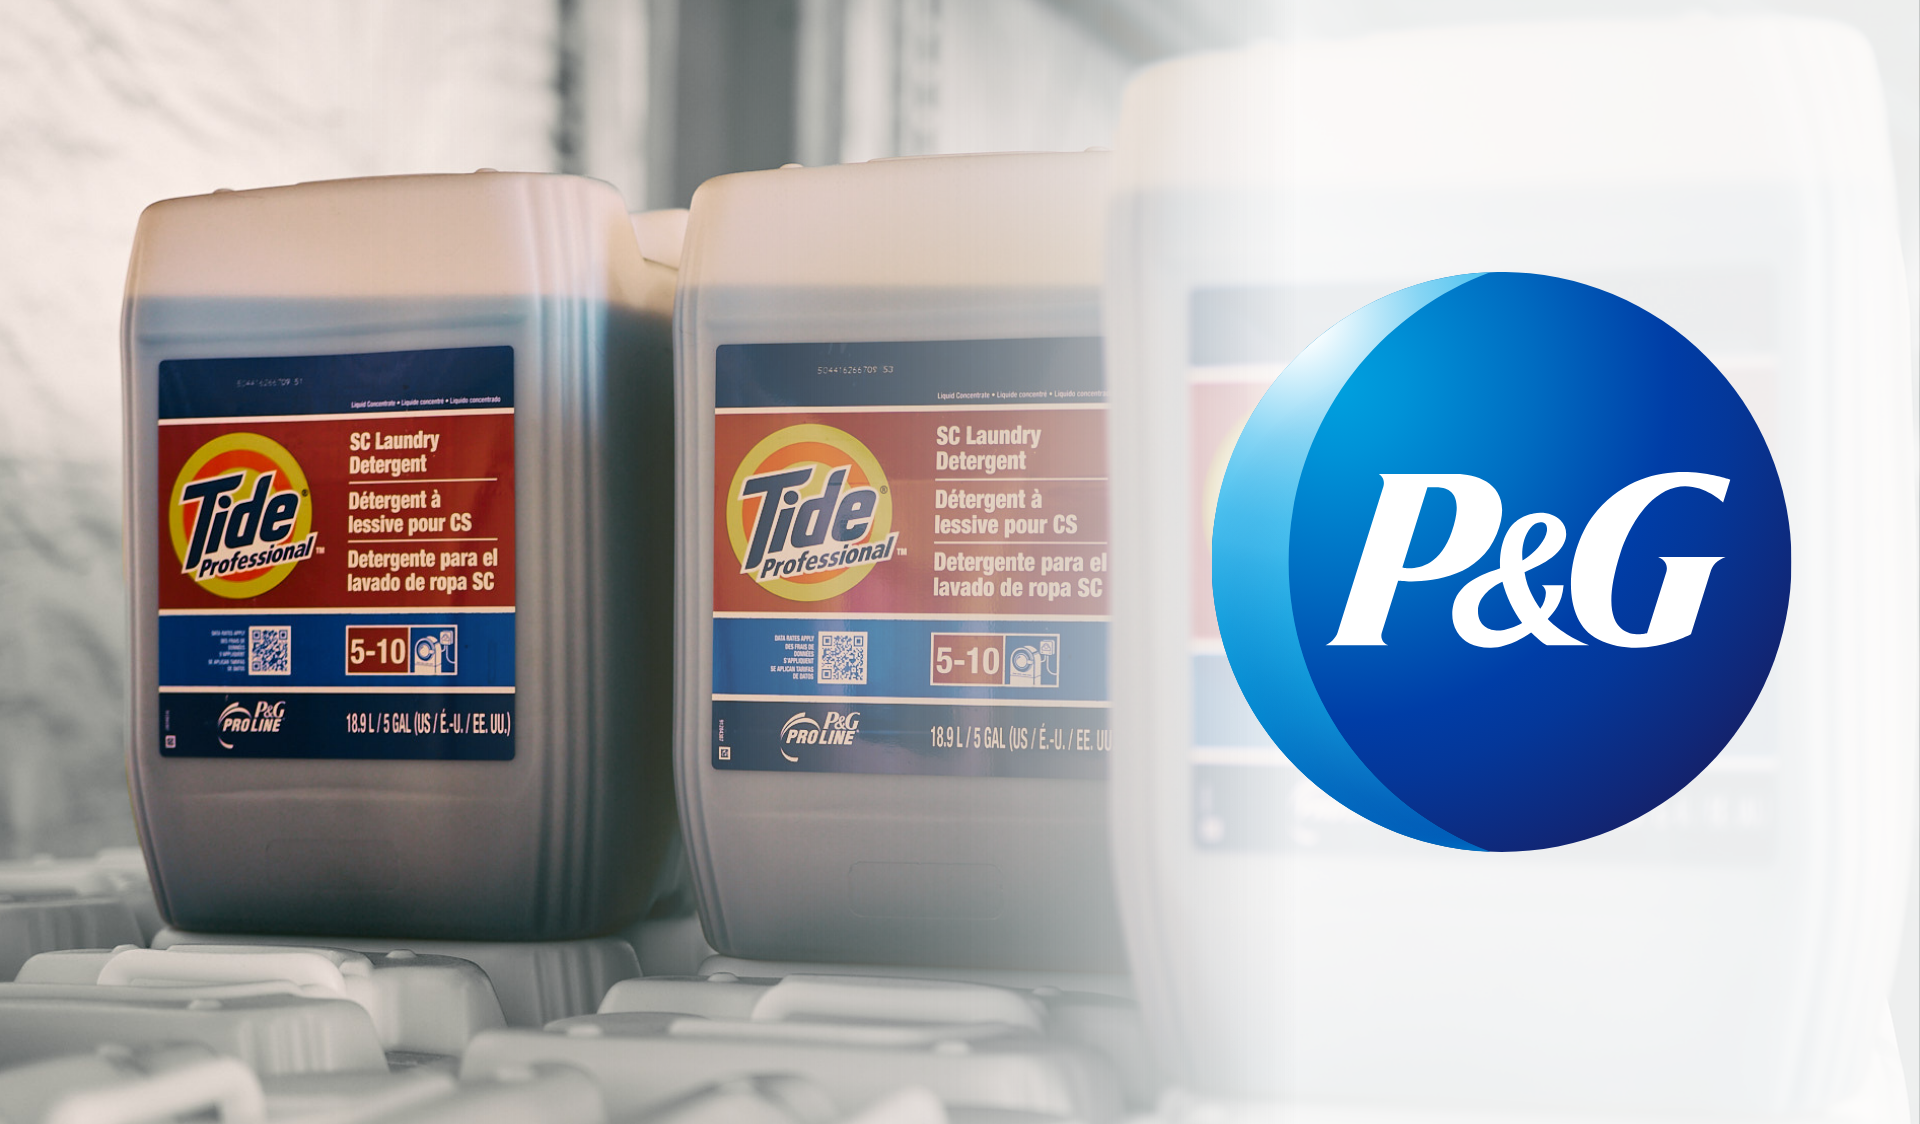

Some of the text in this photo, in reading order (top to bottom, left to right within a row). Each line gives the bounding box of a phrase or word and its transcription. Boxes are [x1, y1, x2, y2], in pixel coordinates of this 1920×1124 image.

[351, 401, 366, 409] Liquid
[367, 400, 396, 408] Concentrate
[937, 391, 955, 400] Liquid
[956, 391, 990, 399] Concentrate
[996, 391, 1018, 399] Liquide
[1019, 390, 1047, 398] concentré
[1077, 390, 1109, 398] concentra
[350, 430, 440, 452] SC Laundry
[936, 425, 1042, 449] SC Laundry
[349, 454, 427, 477] Detergent
[936, 450, 1027, 475] Detergent
[348, 488, 441, 513] Détergent à
[935, 488, 1042, 513] Détergent à
[178, 470, 302, 574] Tide
[348, 512, 472, 536] lessive pour CS
[738, 464, 879, 574] Tide
[934, 514, 1078, 538] lessive pour CS
[197, 534, 316, 579] Professional
[347, 547, 498, 572] Detergente para el
[759, 534, 896, 580] Professional
[934, 551, 1107, 576] Detergente para el
[347, 571, 495, 595] lavado de ropa SC
[933, 577, 1103, 601] lavado de ropa SC
[350, 638, 406, 664] 5-10
[936, 647, 1000, 675] 5-10
[254, 700, 286, 718] P&G
[822, 711, 861, 731] P&G
[346, 712, 367, 733] 18.9
[368, 712, 375, 733] L
[383, 713, 390, 733] 5
[392, 712, 411, 734] GAL
[414, 711, 431, 736] (US
[473, 713, 488, 734] EE.
[490, 711, 511, 737] UU.)
[930, 726, 954, 748] 18.9
[956, 726, 963, 748] L
[973, 727, 981, 748] 5
[984, 727, 1006, 749] GAL
[1009, 725, 1028, 752] (US
[1076, 729, 1093, 750] EE.
[1096, 730, 1113, 751] UU
